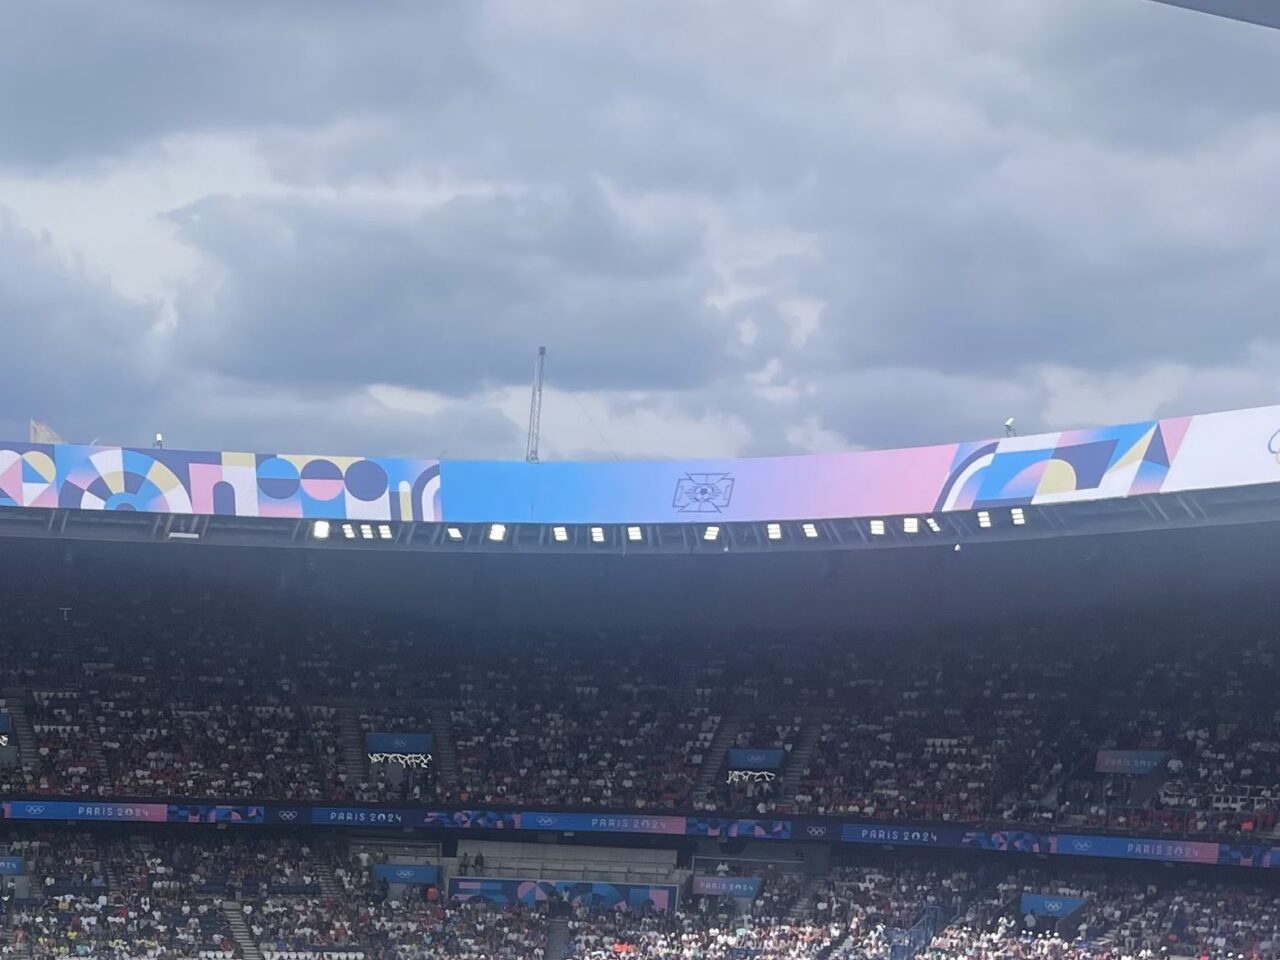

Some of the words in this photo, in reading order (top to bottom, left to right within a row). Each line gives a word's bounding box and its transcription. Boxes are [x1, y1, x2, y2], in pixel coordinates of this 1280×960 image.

[78, 806, 113, 816] PARIS
[116, 807, 149, 817] 2024
[330, 811, 366, 822] PARIS
[370, 812, 402, 823] 2024
[591, 817, 629, 828] PARIS
[632, 818, 666, 829] 2024
[862, 829, 898, 840] PARIS
[903, 831, 937, 842] 2024
